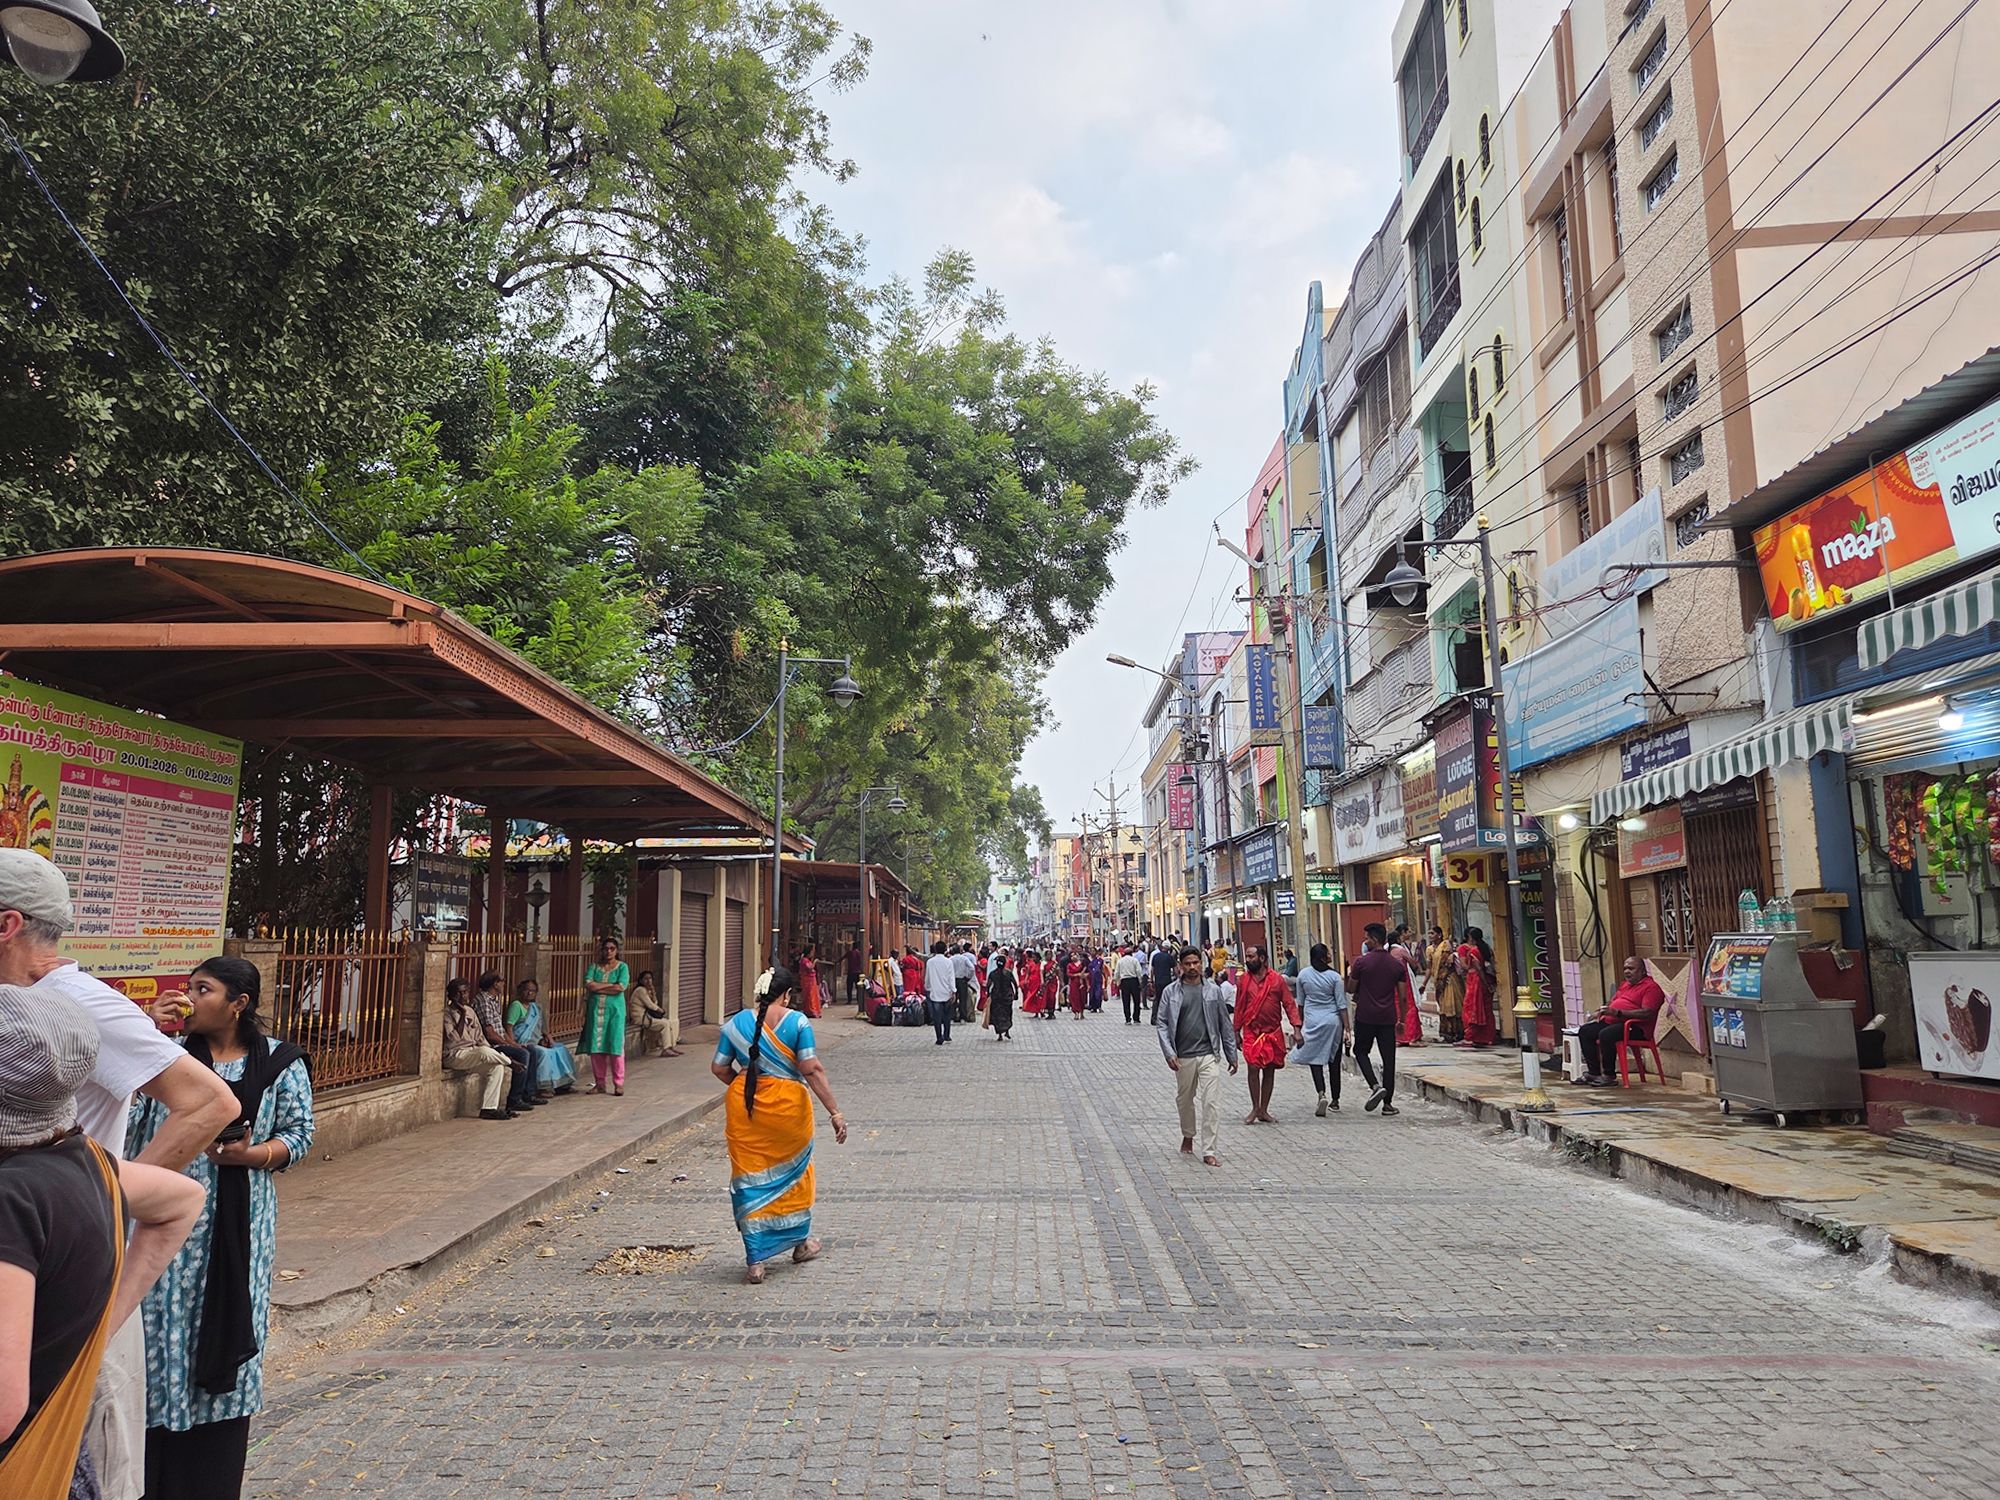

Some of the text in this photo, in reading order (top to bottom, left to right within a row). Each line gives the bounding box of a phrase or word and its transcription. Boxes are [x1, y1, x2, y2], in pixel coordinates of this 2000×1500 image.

[1822, 513, 1896, 568] maaza
[42, 702, 87, 728] மீனாட்சி
[1474, 698, 1489, 710] SRI
[120, 752, 177, 774] 20.01.2026
[185, 766, 234, 787] 01.02.2026
[1447, 754, 1474, 783] LODGE
[1485, 831, 1539, 844] Loge
[1450, 858, 1485, 884] 31
